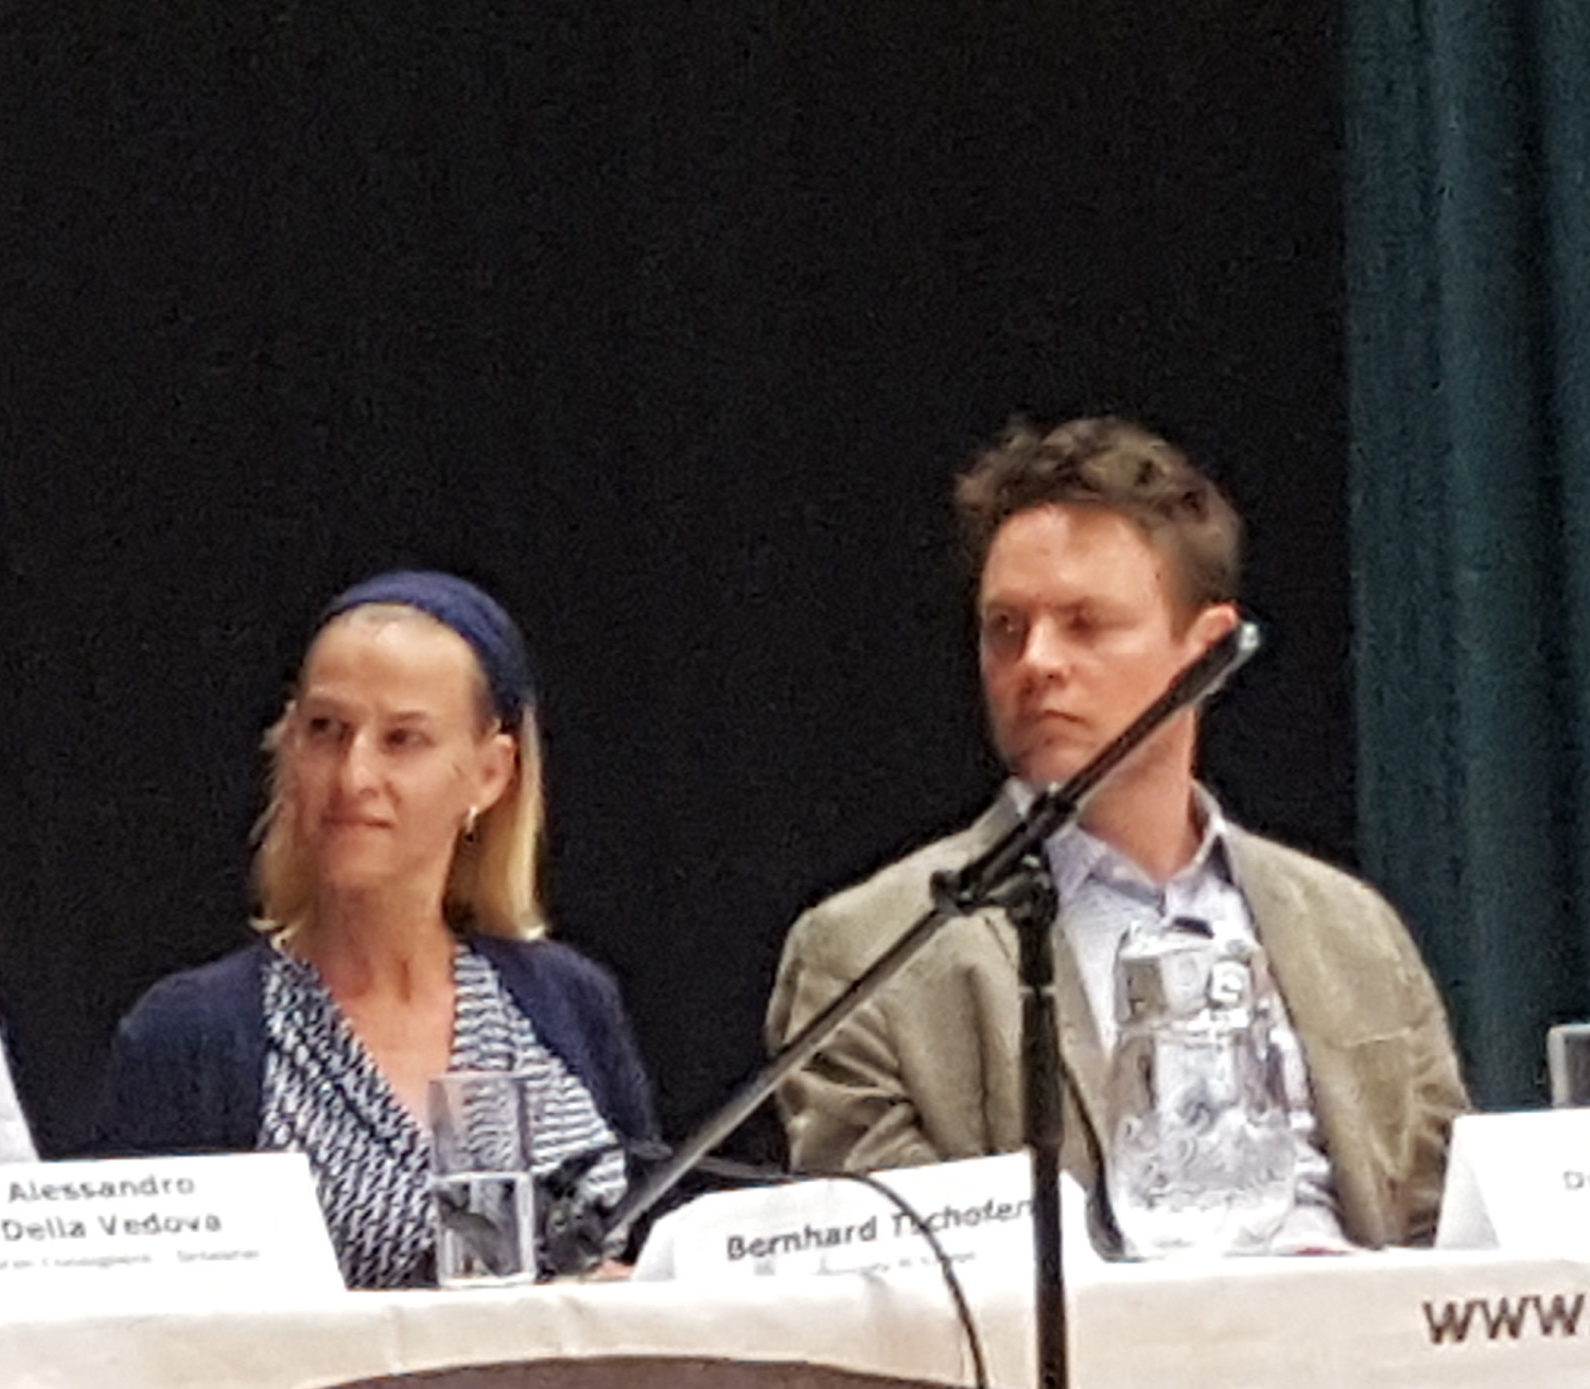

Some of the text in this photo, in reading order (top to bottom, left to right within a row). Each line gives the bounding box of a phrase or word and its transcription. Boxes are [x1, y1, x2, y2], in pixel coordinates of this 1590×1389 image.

[7, 1172, 196, 1204] Alessandro
[0, 1211, 223, 1242] Della Vedova
[726, 1215, 878, 1262] Bernhard
